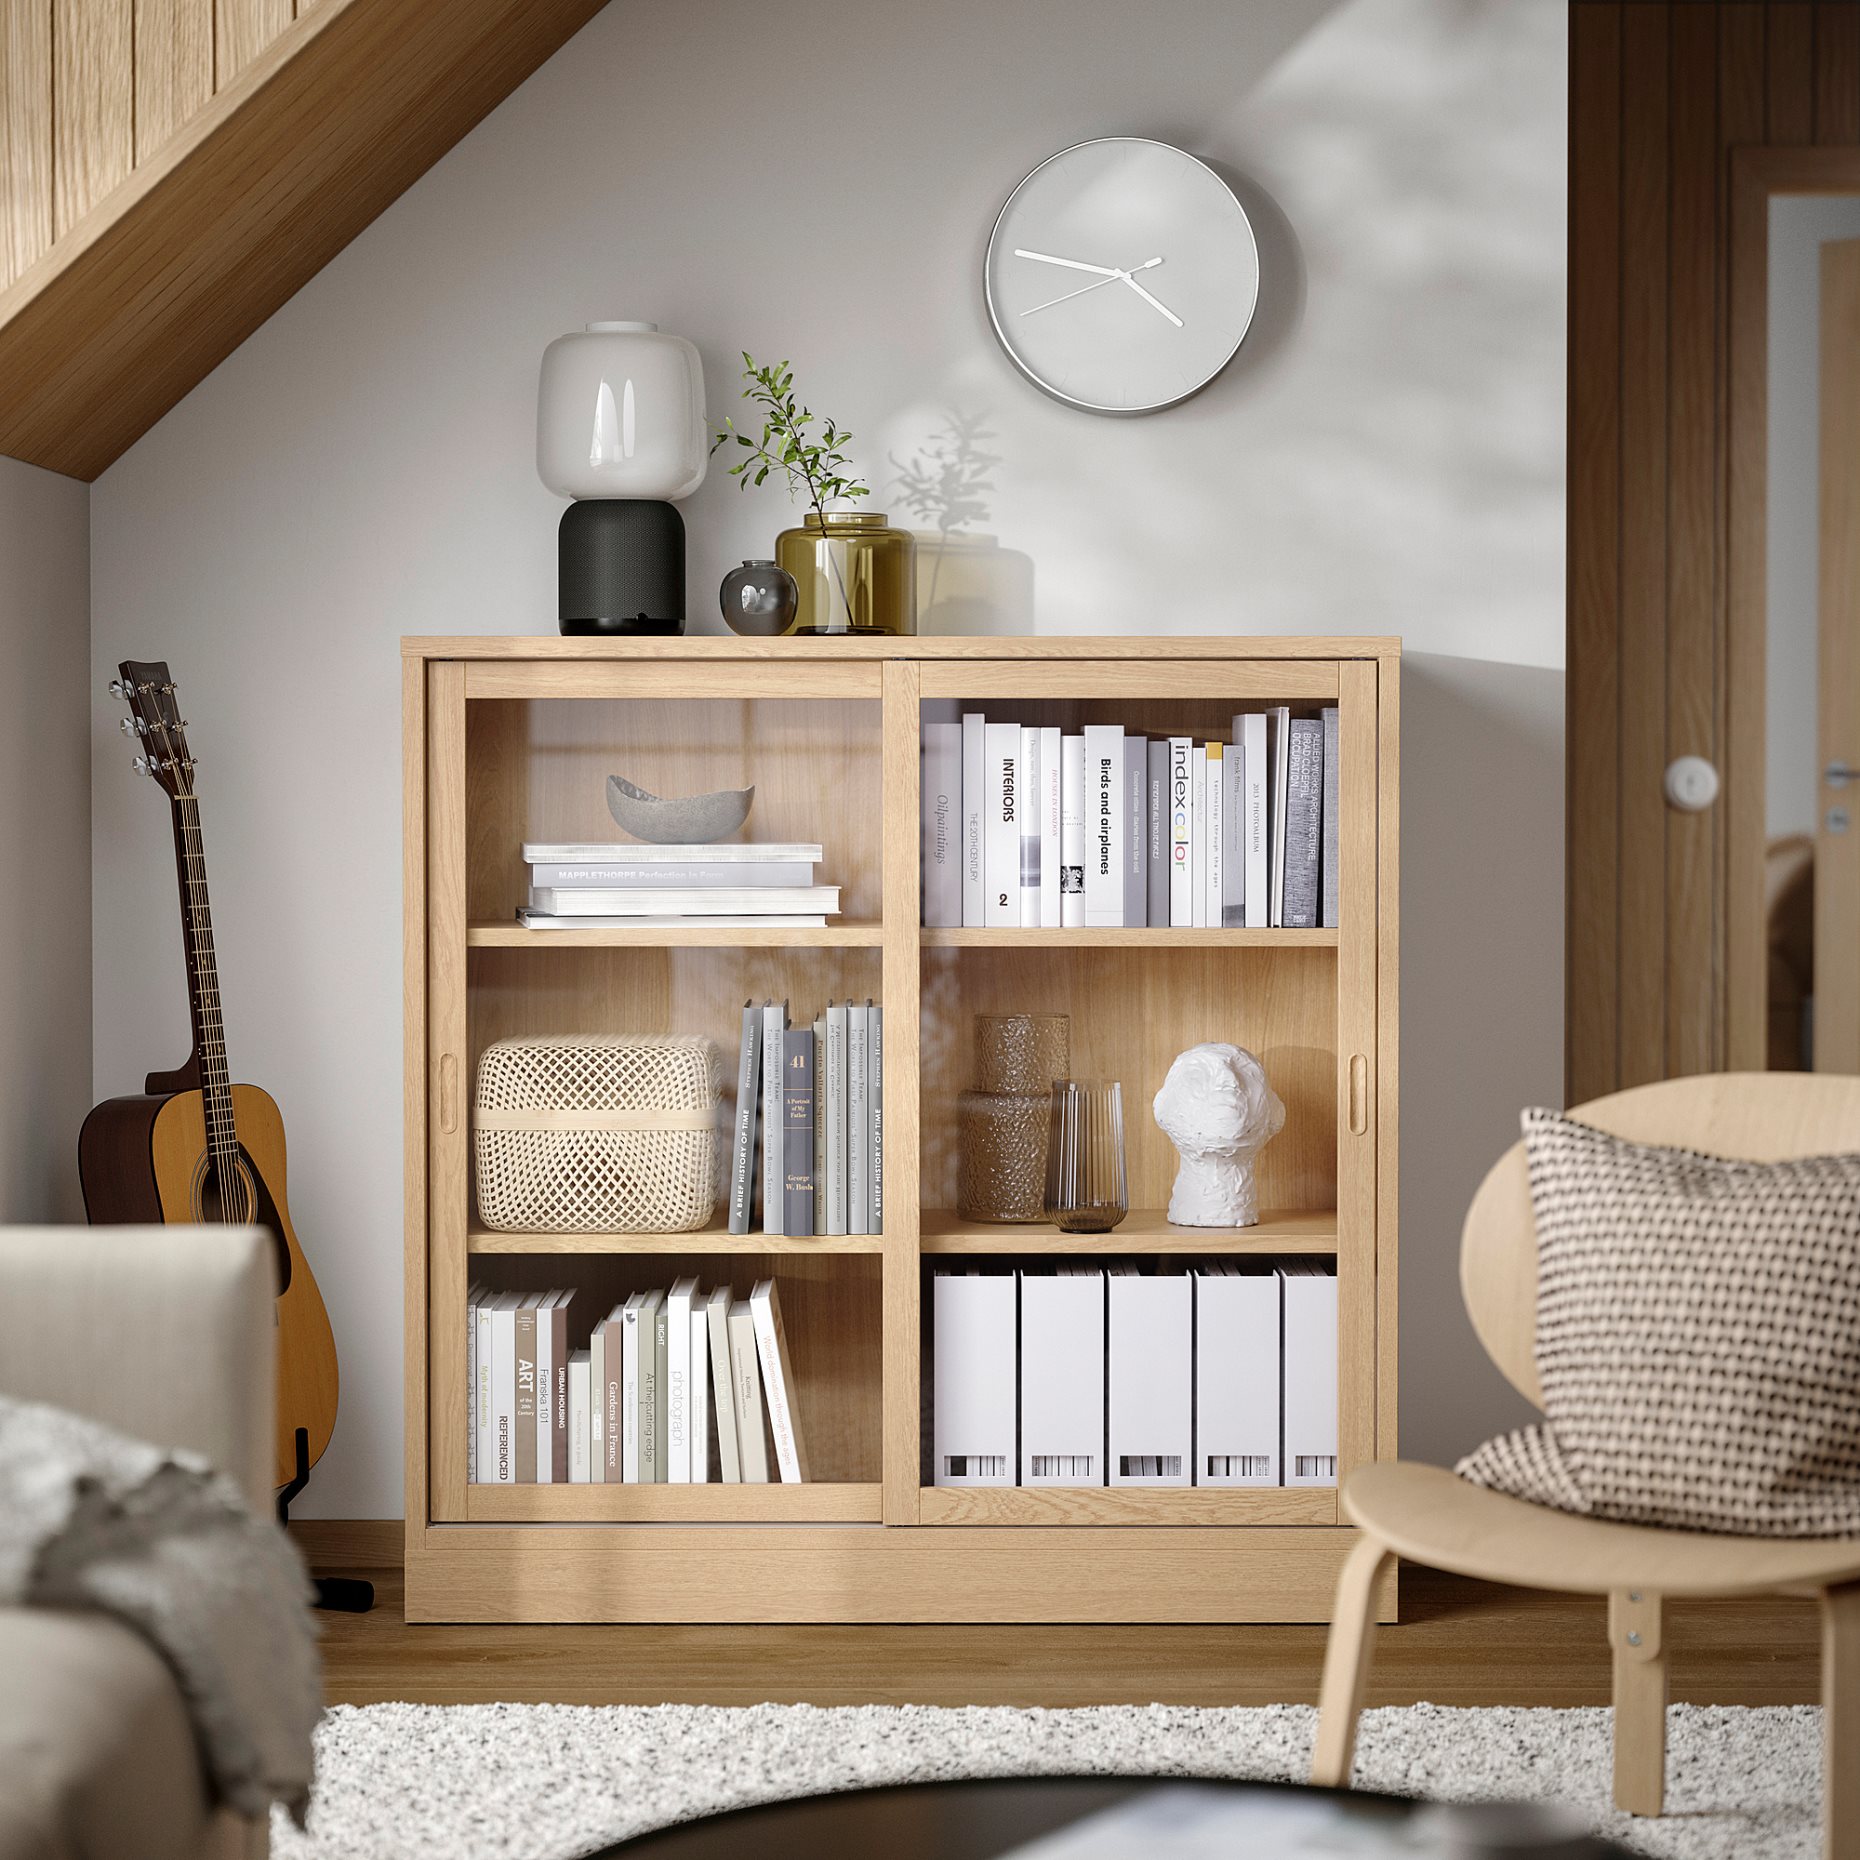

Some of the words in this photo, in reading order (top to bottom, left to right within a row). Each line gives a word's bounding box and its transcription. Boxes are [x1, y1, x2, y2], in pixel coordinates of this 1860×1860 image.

[1303, 733, 1311, 756] BRAD
[1312, 733, 1320, 762] ALLIED
[1101, 758, 1111, 788] Birds
[1291, 733, 1300, 788] OCCUPATION
[1003, 758, 1014, 822] INTERIORS
[1175, 745, 1188, 809] index
[1300, 758, 1310, 798] CLOEPFIL
[1311, 763, 1319, 794] WORKS
[1052, 798, 1057, 806] IN
[1101, 792, 1111, 815] and
[935, 795, 948, 864] Oilpaintings
[1175, 813, 1188, 871] color
[1308, 796, 1318, 861] ARCHITECTURE
[1098, 818, 1111, 875] airplanes
[559, 872, 636, 880] MAPPLETHORPE
[639, 872, 686, 880] Perfection
[999, 894, 1008, 906] 2
[790, 1055, 805, 1068] 41
[740, 1129, 748, 1144] OF
[875, 1129, 881, 1144] OF
[738, 1147, 747, 1182] HISTORY
[763, 1336, 774, 1359] World
[480, 1365, 488, 1383] Myth
[519, 1359, 533, 1392] ART
[646, 1373, 654, 1384] At
[718, 1360, 727, 1381] Over
[767, 1360, 780, 1402] domination
[540, 1369, 549, 1404] Franska
[646, 1387, 654, 1401] the
[719, 1383, 728, 1397] the
[480, 1393, 488, 1428] modernity
[540, 1408, 549, 1423] 101
[609, 1382, 617, 1421] Gardens
[671, 1371, 684, 1446] photograph
[718, 1399, 729, 1413] top
[609, 1423, 617, 1432] in
[644, 1404, 654, 1436] cutting
[775, 1403, 787, 1432] through
[499, 1416, 508, 1480] REFERENCED
[609, 1434, 617, 1467] France
[644, 1438, 654, 1462] edge
[780, 1433, 789, 1447] the
[780, 1447, 792, 1465] ages
